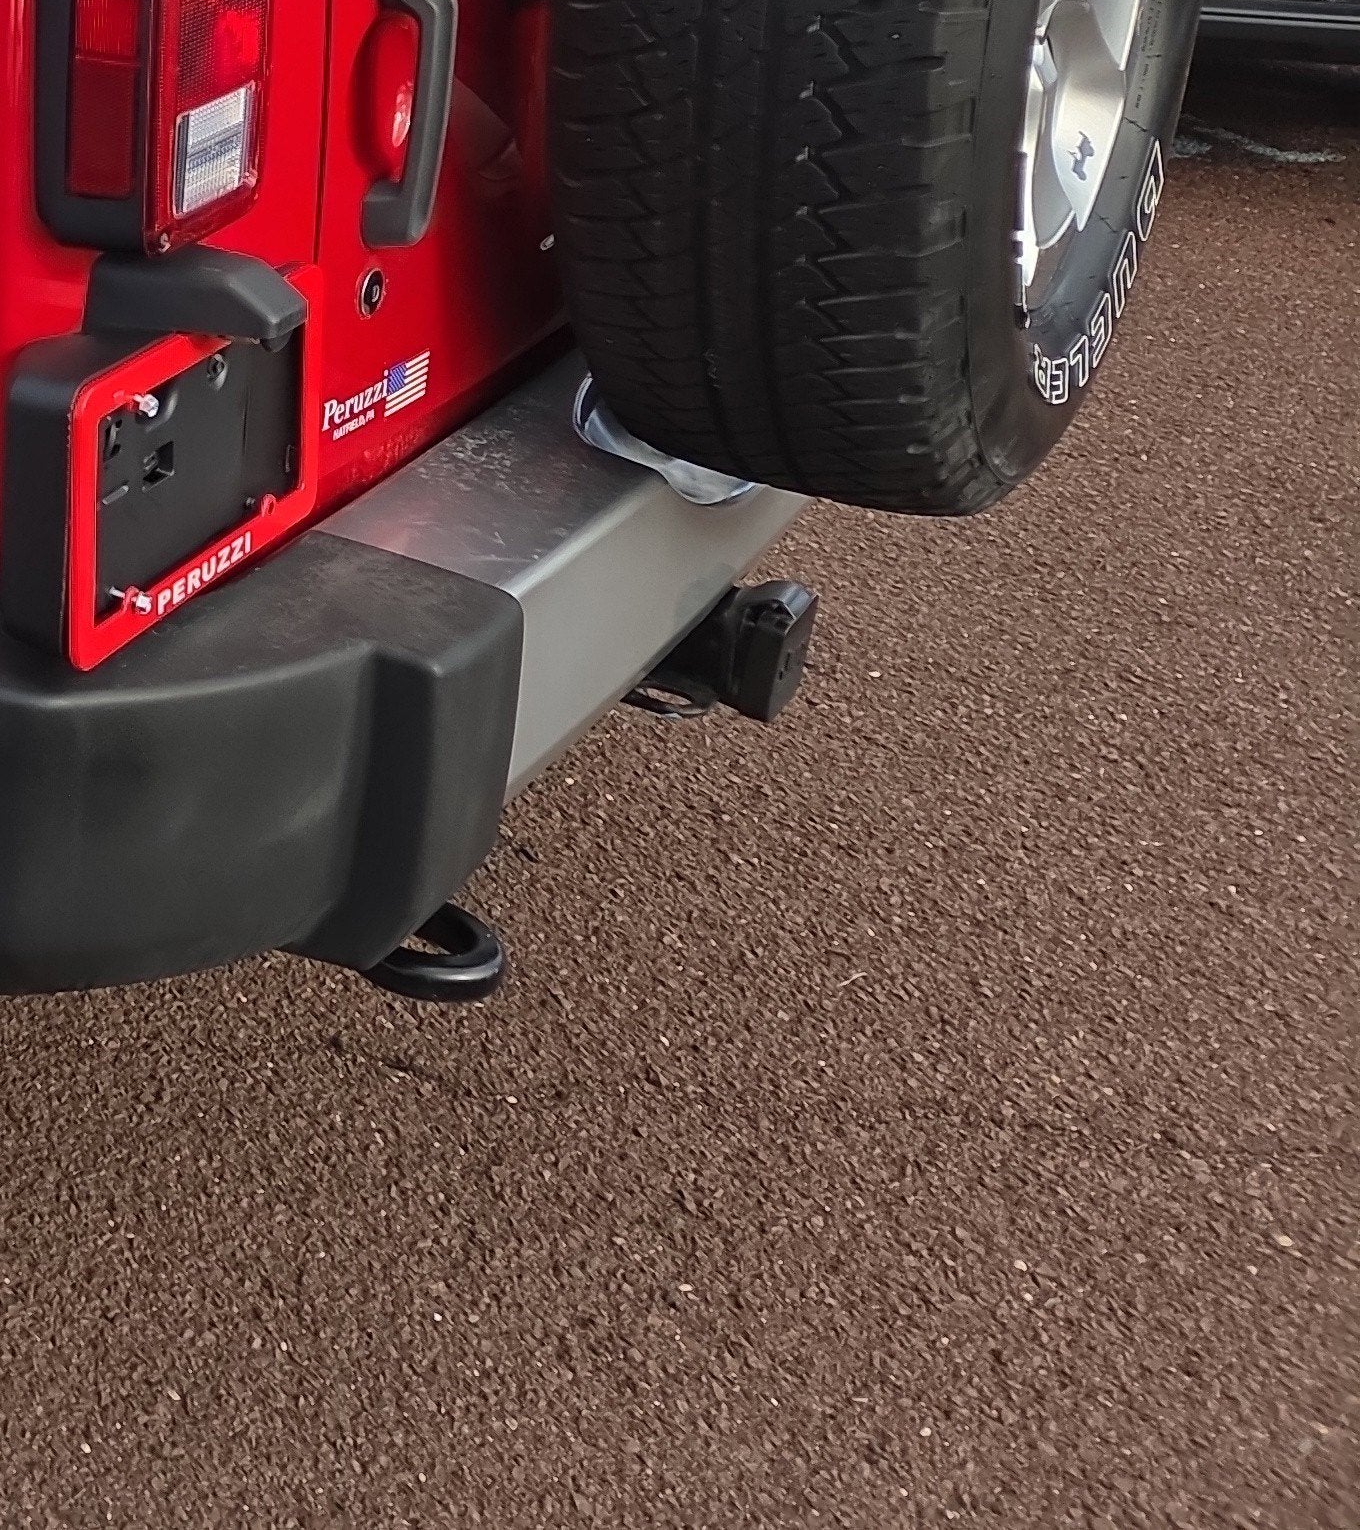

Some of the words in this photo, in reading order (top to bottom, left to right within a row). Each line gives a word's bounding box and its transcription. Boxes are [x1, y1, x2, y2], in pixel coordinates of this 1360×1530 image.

[1033, 139, 1166, 405] DUELER
[322, 369, 389, 432] Peruzzi
[157, 531, 251, 616] PERUZZI
